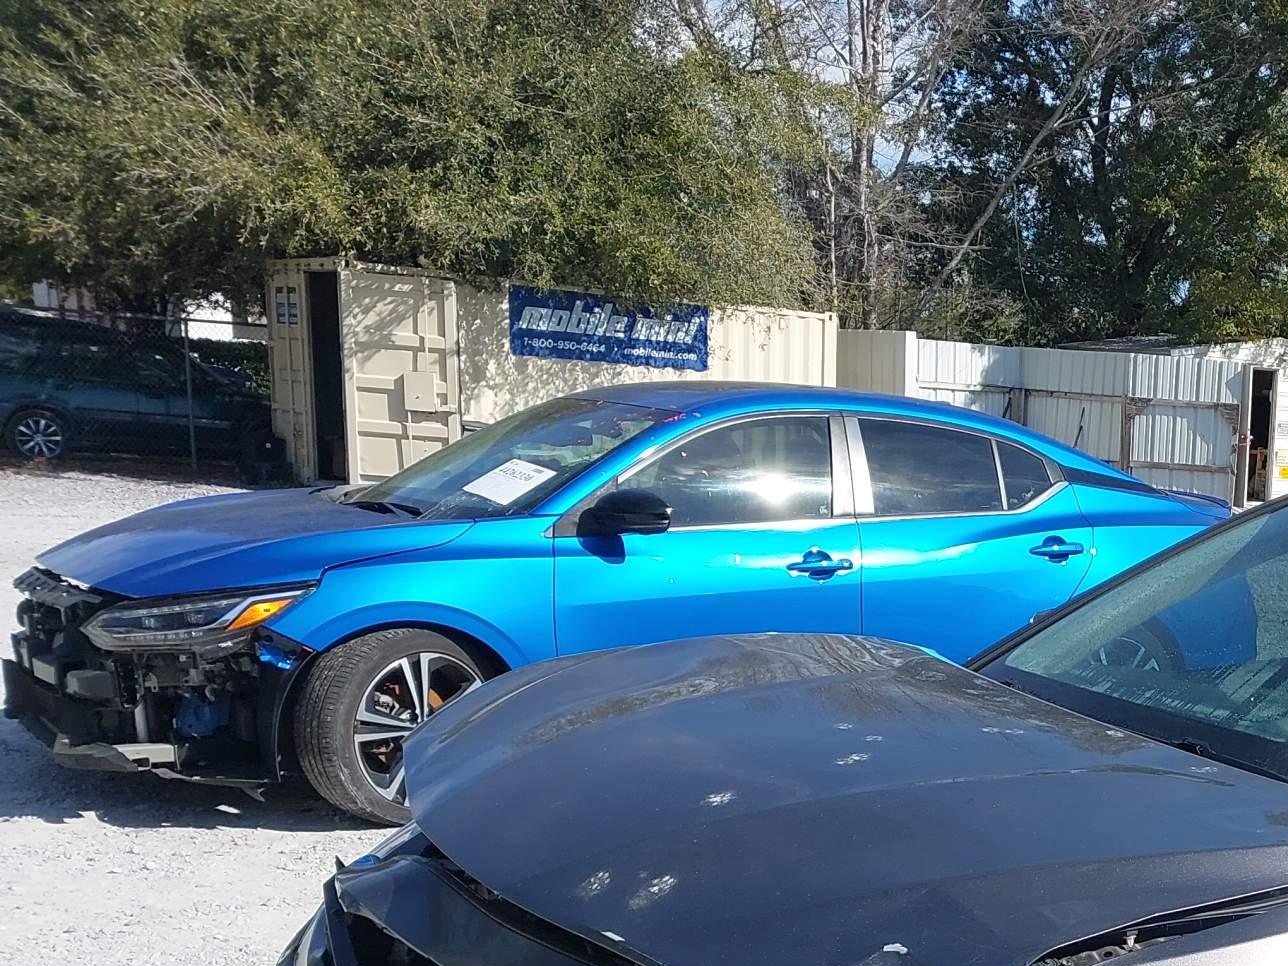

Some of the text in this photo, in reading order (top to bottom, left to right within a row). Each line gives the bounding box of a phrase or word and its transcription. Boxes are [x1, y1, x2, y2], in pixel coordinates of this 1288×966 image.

[519, 301, 702, 344] mobile mini
[523, 338, 606, 352] 1-800-950-6464
